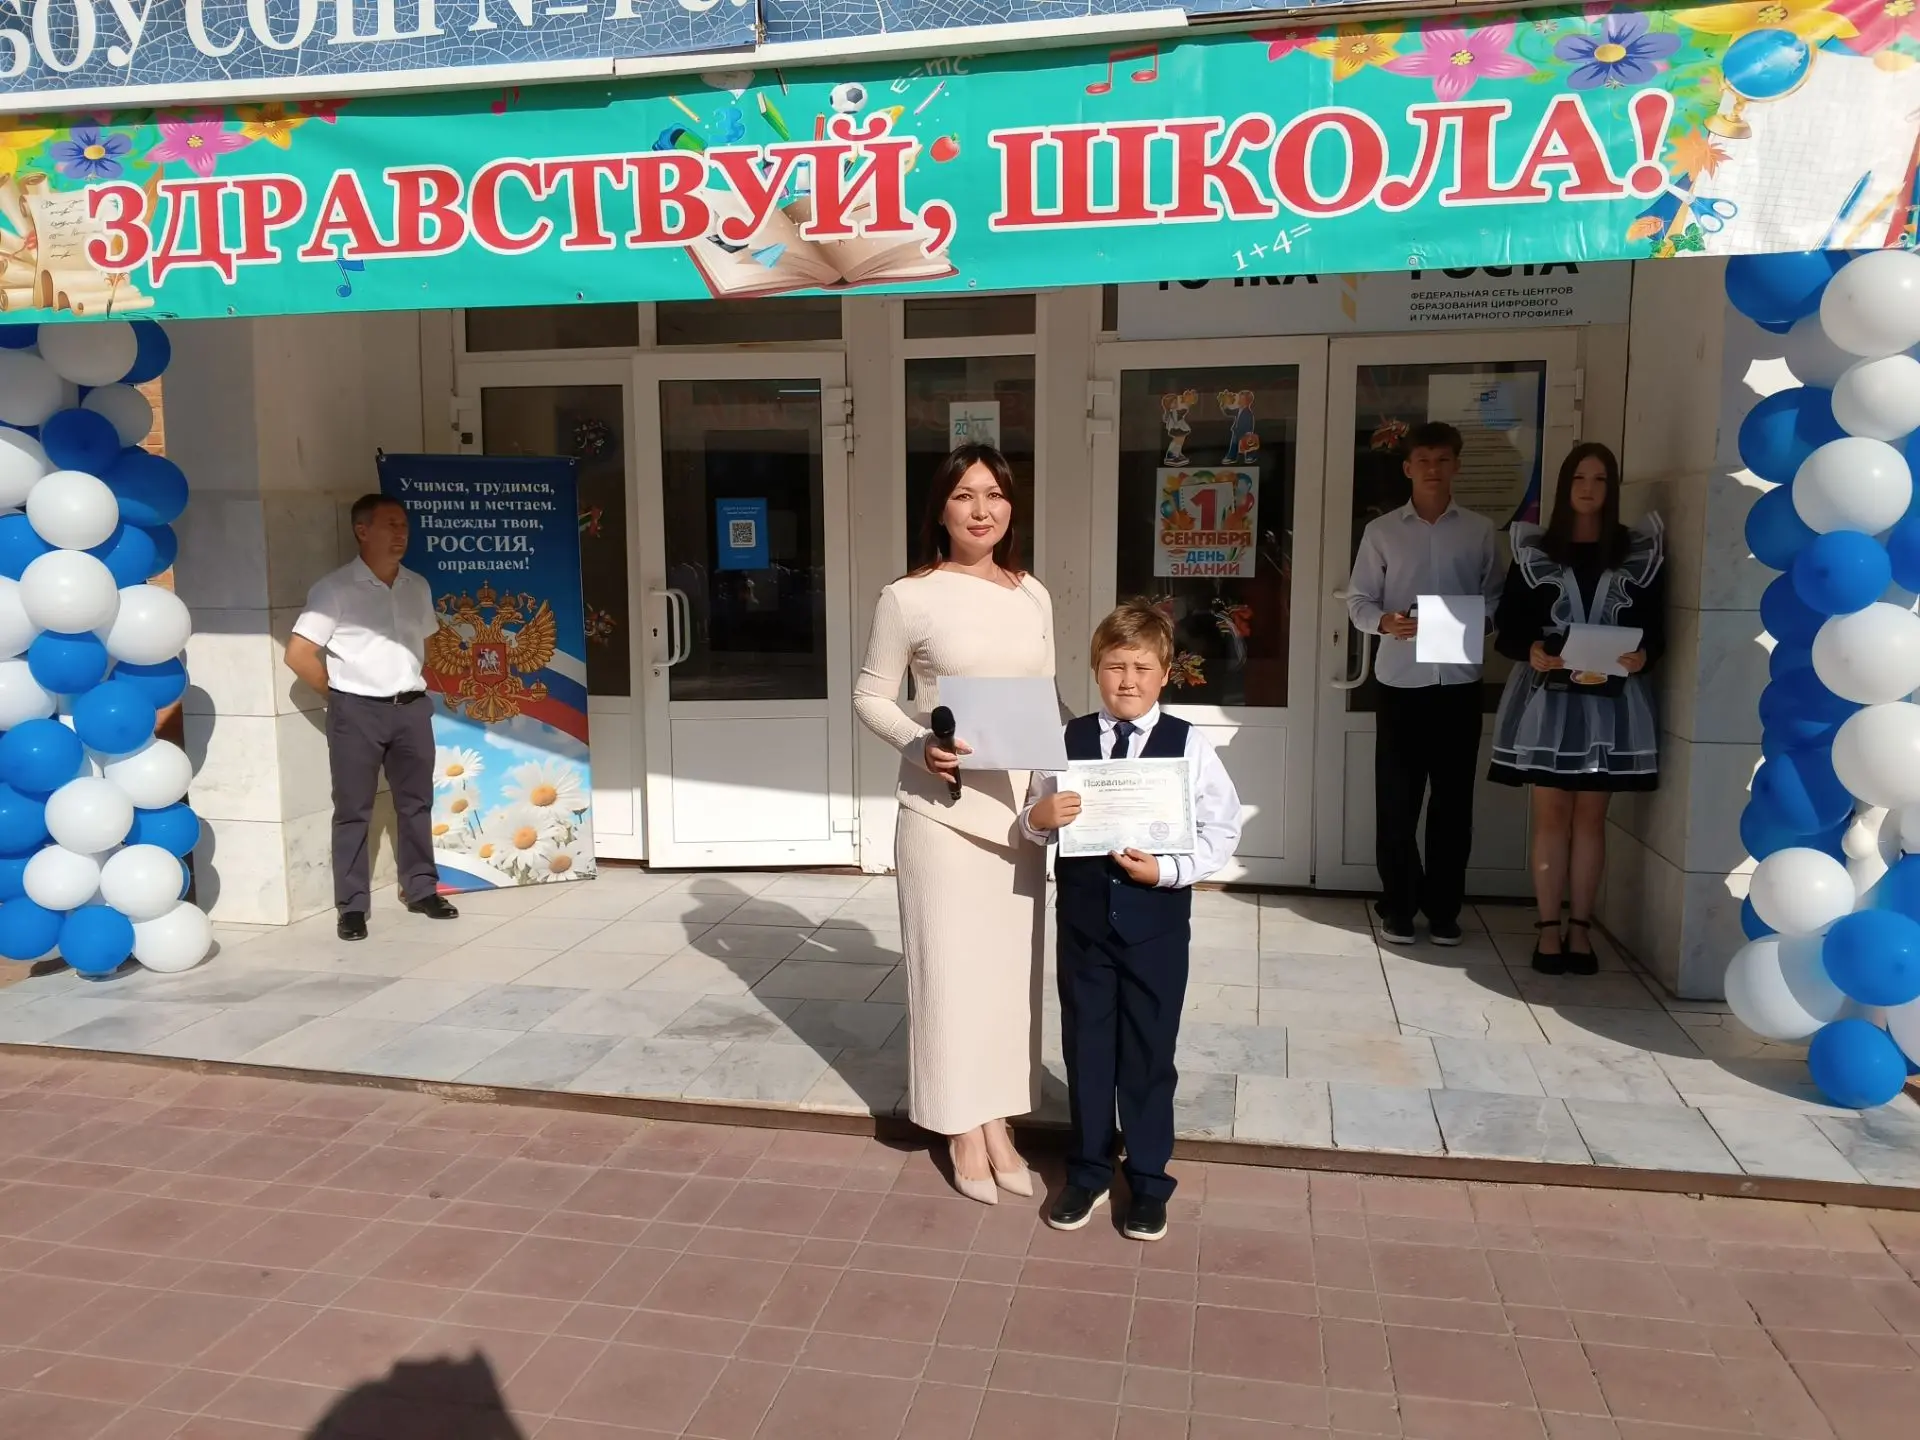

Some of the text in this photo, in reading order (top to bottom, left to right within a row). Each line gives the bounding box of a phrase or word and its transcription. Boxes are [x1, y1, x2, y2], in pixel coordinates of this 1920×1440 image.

[88, 87, 1676, 287] ЗДРАВСТВУЙ, ШКОЛА!
[1410, 286, 1574, 300] ФЕДЕРАЛЬНАЯ СЕТЬ ЦЕНТРОВ
[1410, 298, 1558, 311] ОБРАЗОВАНИЯ ЦИФРОВОГО
[1420, 311, 1510, 321] ГУМАНИТАРНОГО
[1513, 309, 1574, 320] ПРОФИЛЕЙ
[400, 477, 556, 496] Учимся, трудимся,
[404, 499, 557, 513] творим и мечтаем.
[1190, 488, 1216, 530] 1
[420, 514, 544, 530] Надежды твои,
[426, 535, 535, 555] РОССИЯ,
[1160, 531, 1252, 547] СЕНТЯБРЯ
[1186, 550, 1226, 562] ДЕНЬ
[437, 557, 530, 573] оправдаем!
[1170, 562, 1240, 576] ЗНАНИЙ
